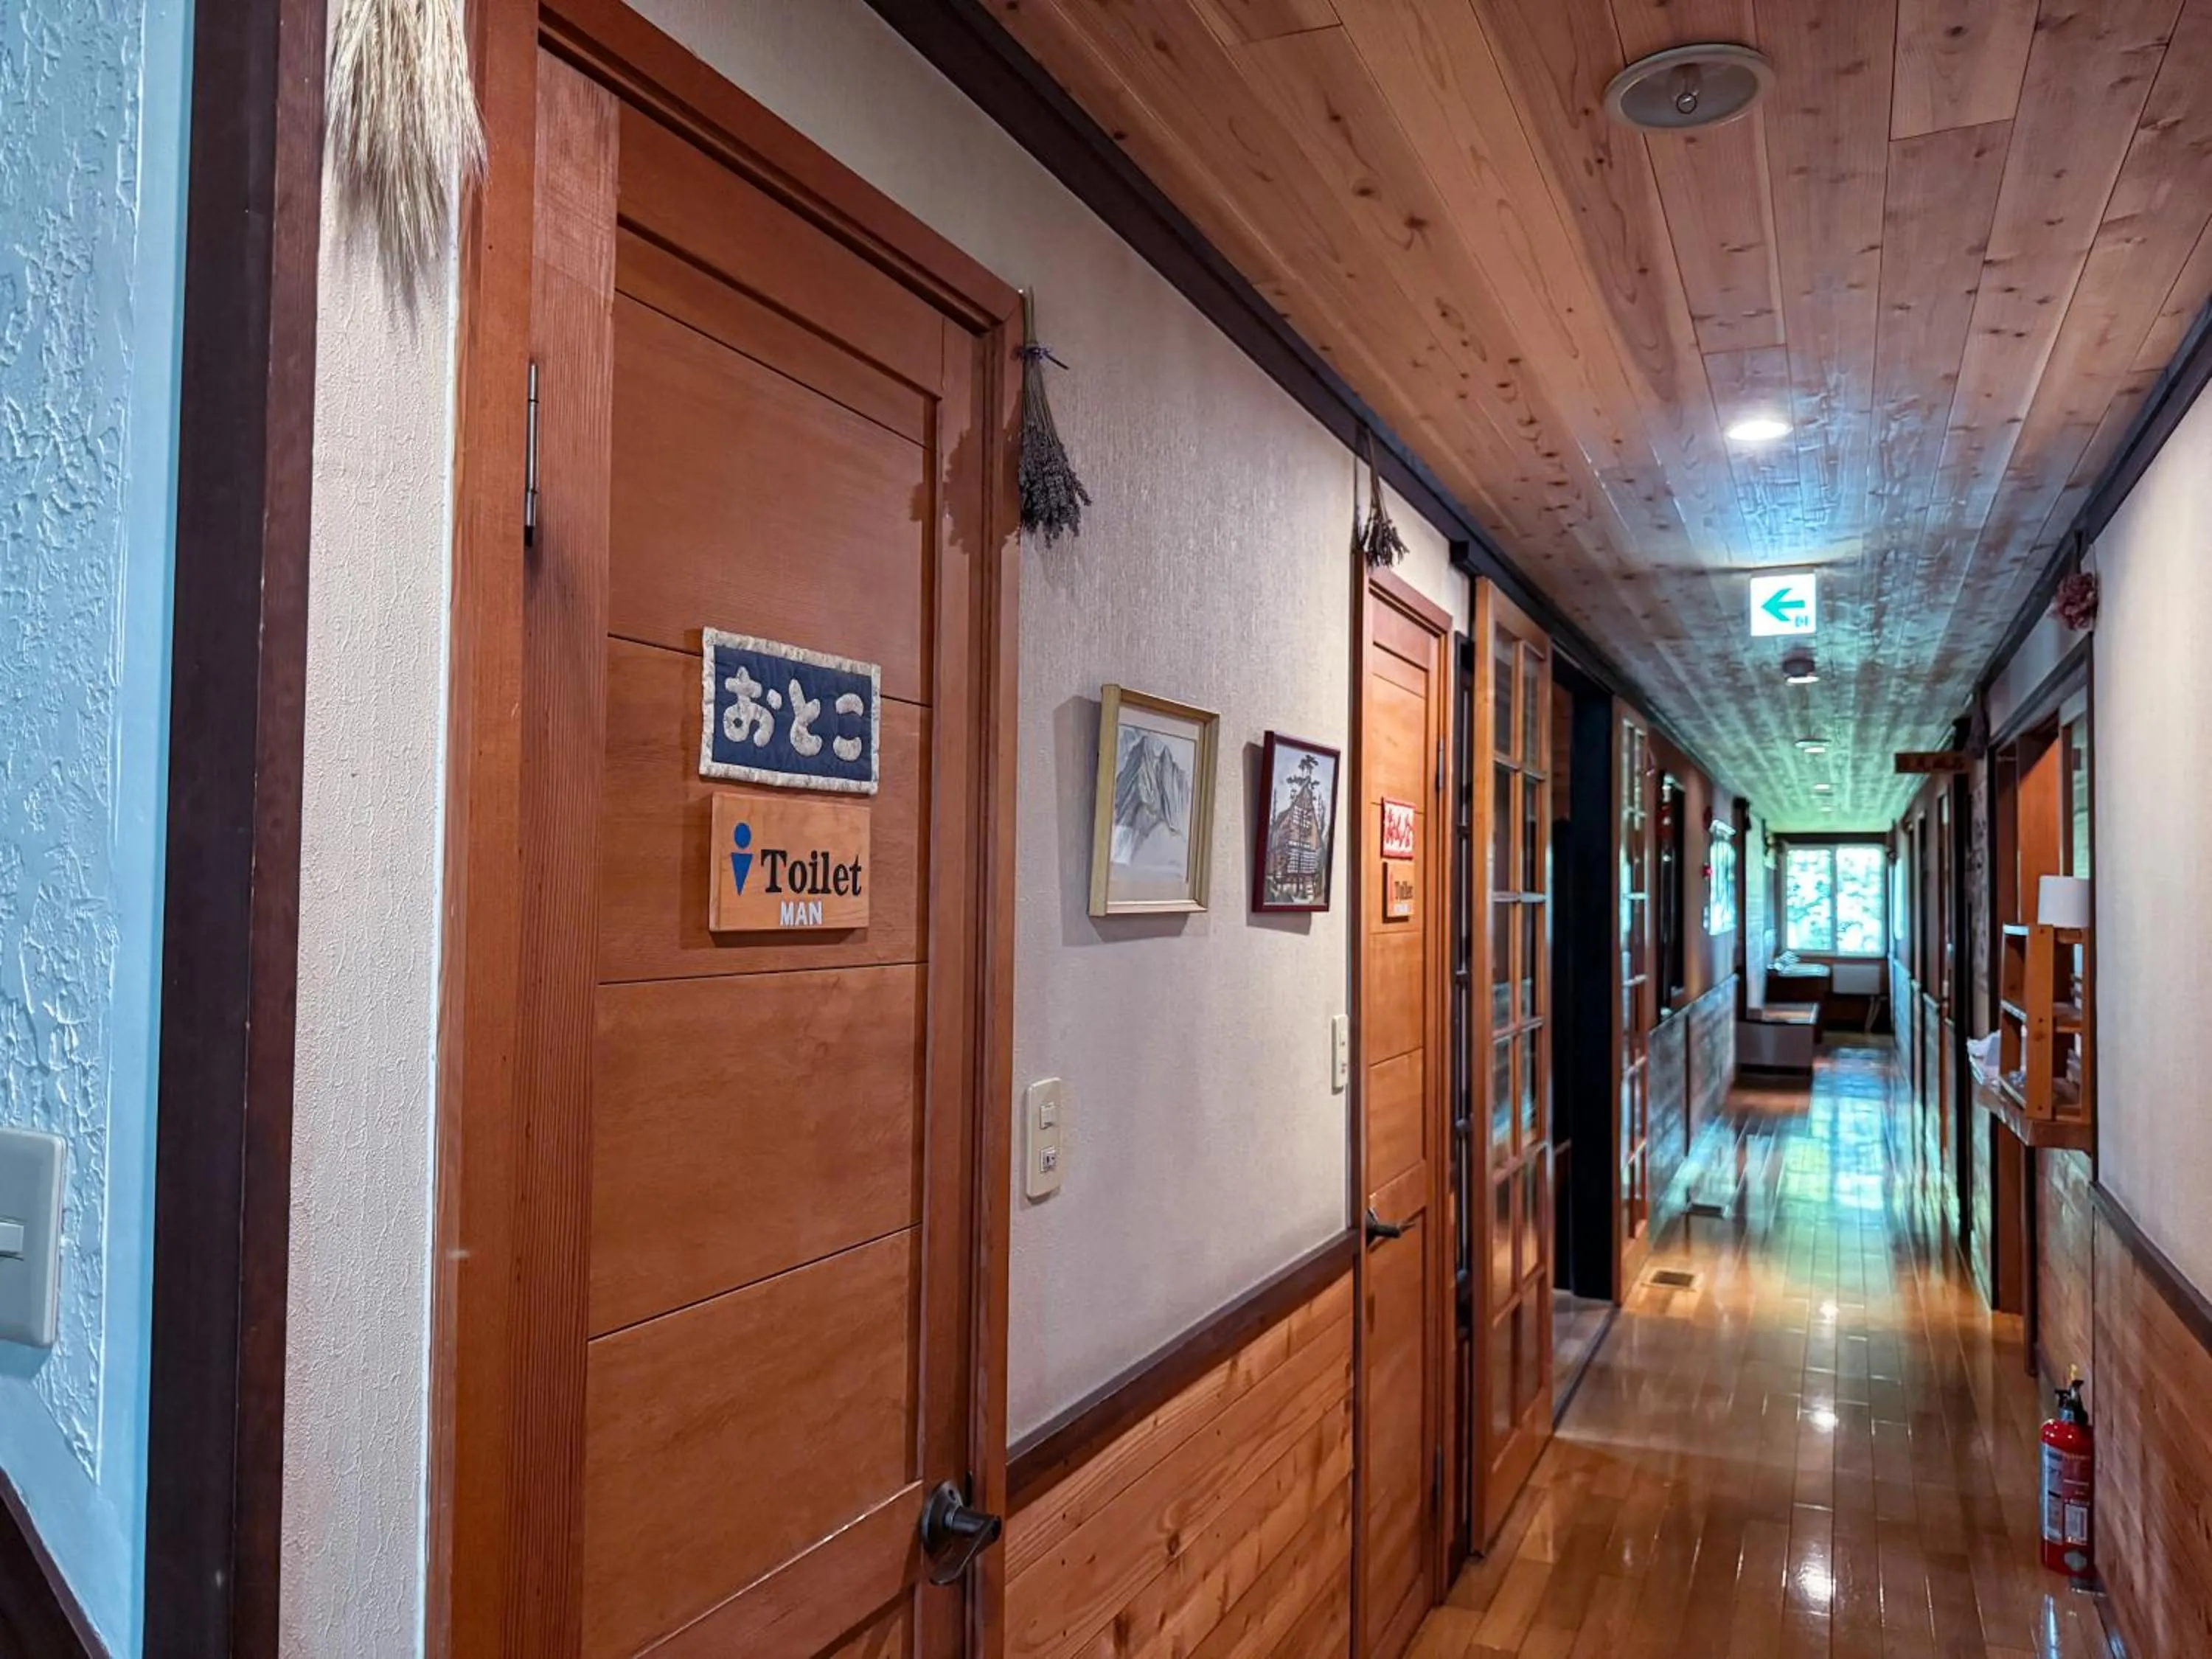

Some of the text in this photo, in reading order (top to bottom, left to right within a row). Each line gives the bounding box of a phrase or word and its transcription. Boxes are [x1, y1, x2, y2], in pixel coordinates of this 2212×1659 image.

[723, 666, 864, 762] おとこ
[760, 849, 863, 897] Toilet
[779, 901, 824, 927] MAN
